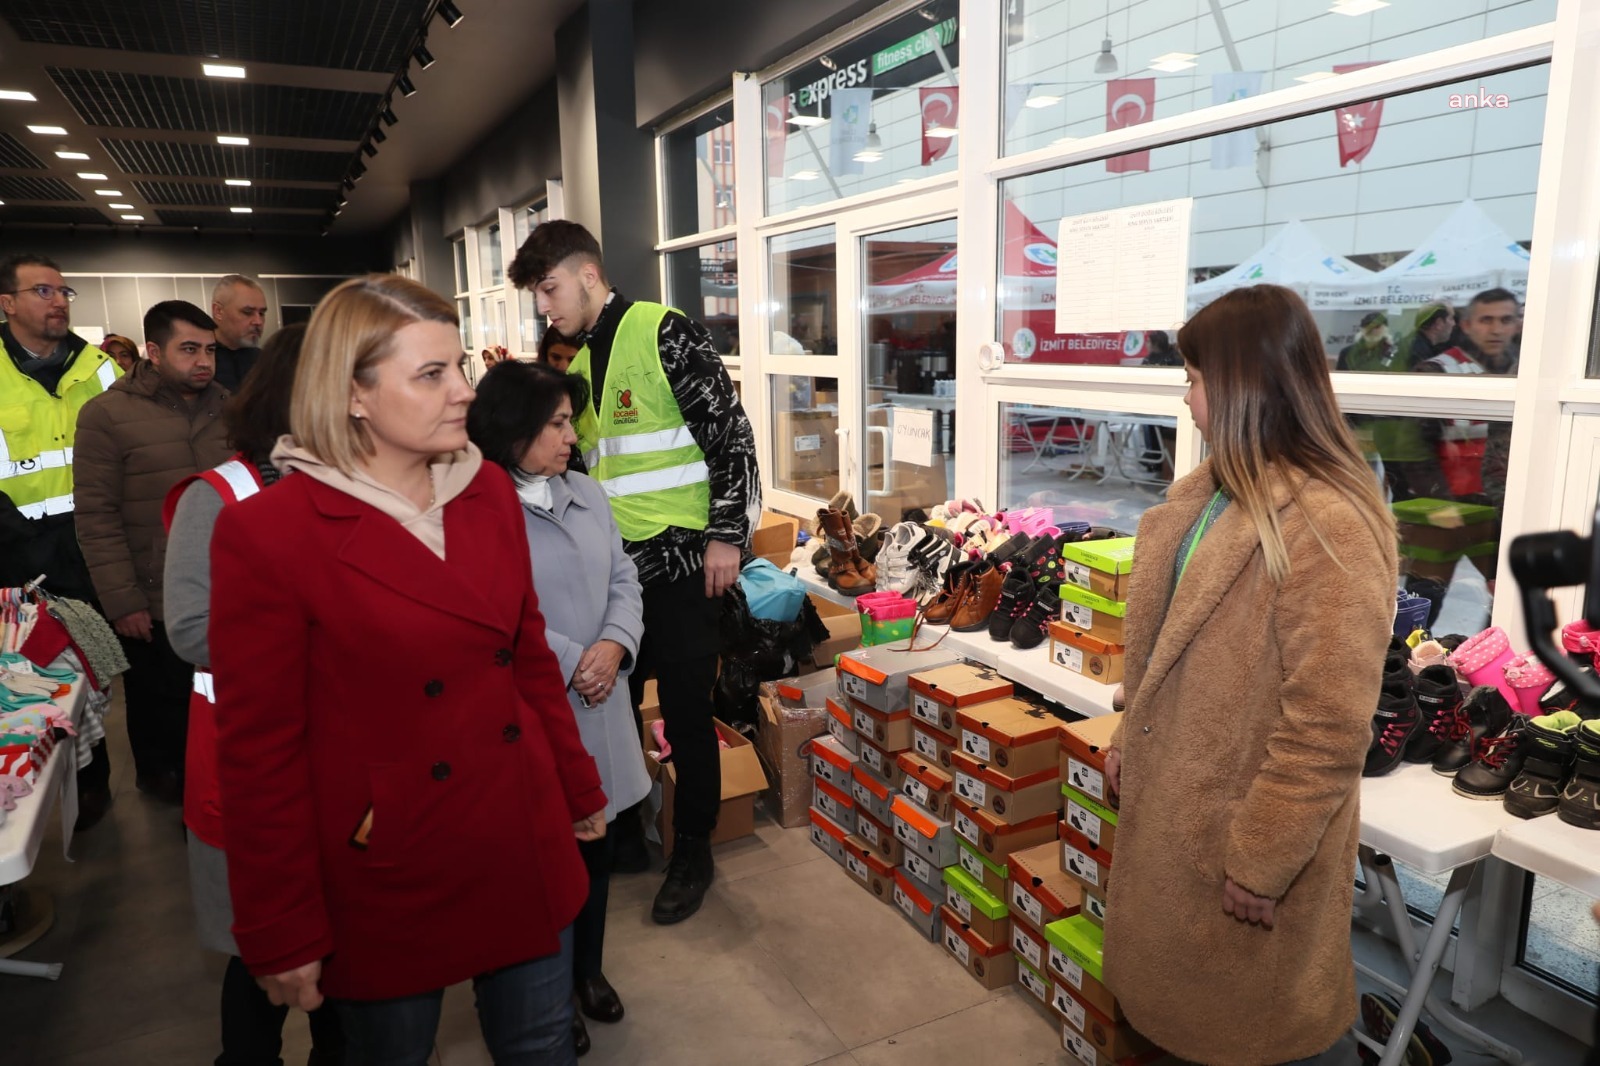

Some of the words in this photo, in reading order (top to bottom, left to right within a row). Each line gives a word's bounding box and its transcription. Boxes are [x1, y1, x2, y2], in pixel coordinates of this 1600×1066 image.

[877, 43, 913, 69] fitness
[800, 58, 867, 107] express
[1040, 338, 1066, 351] İZMİT
[1068, 338, 1121, 351] BELEDİYESİ
[613, 407, 638, 418] kocaeli
[897, 424, 931, 441] OYUNCAK
